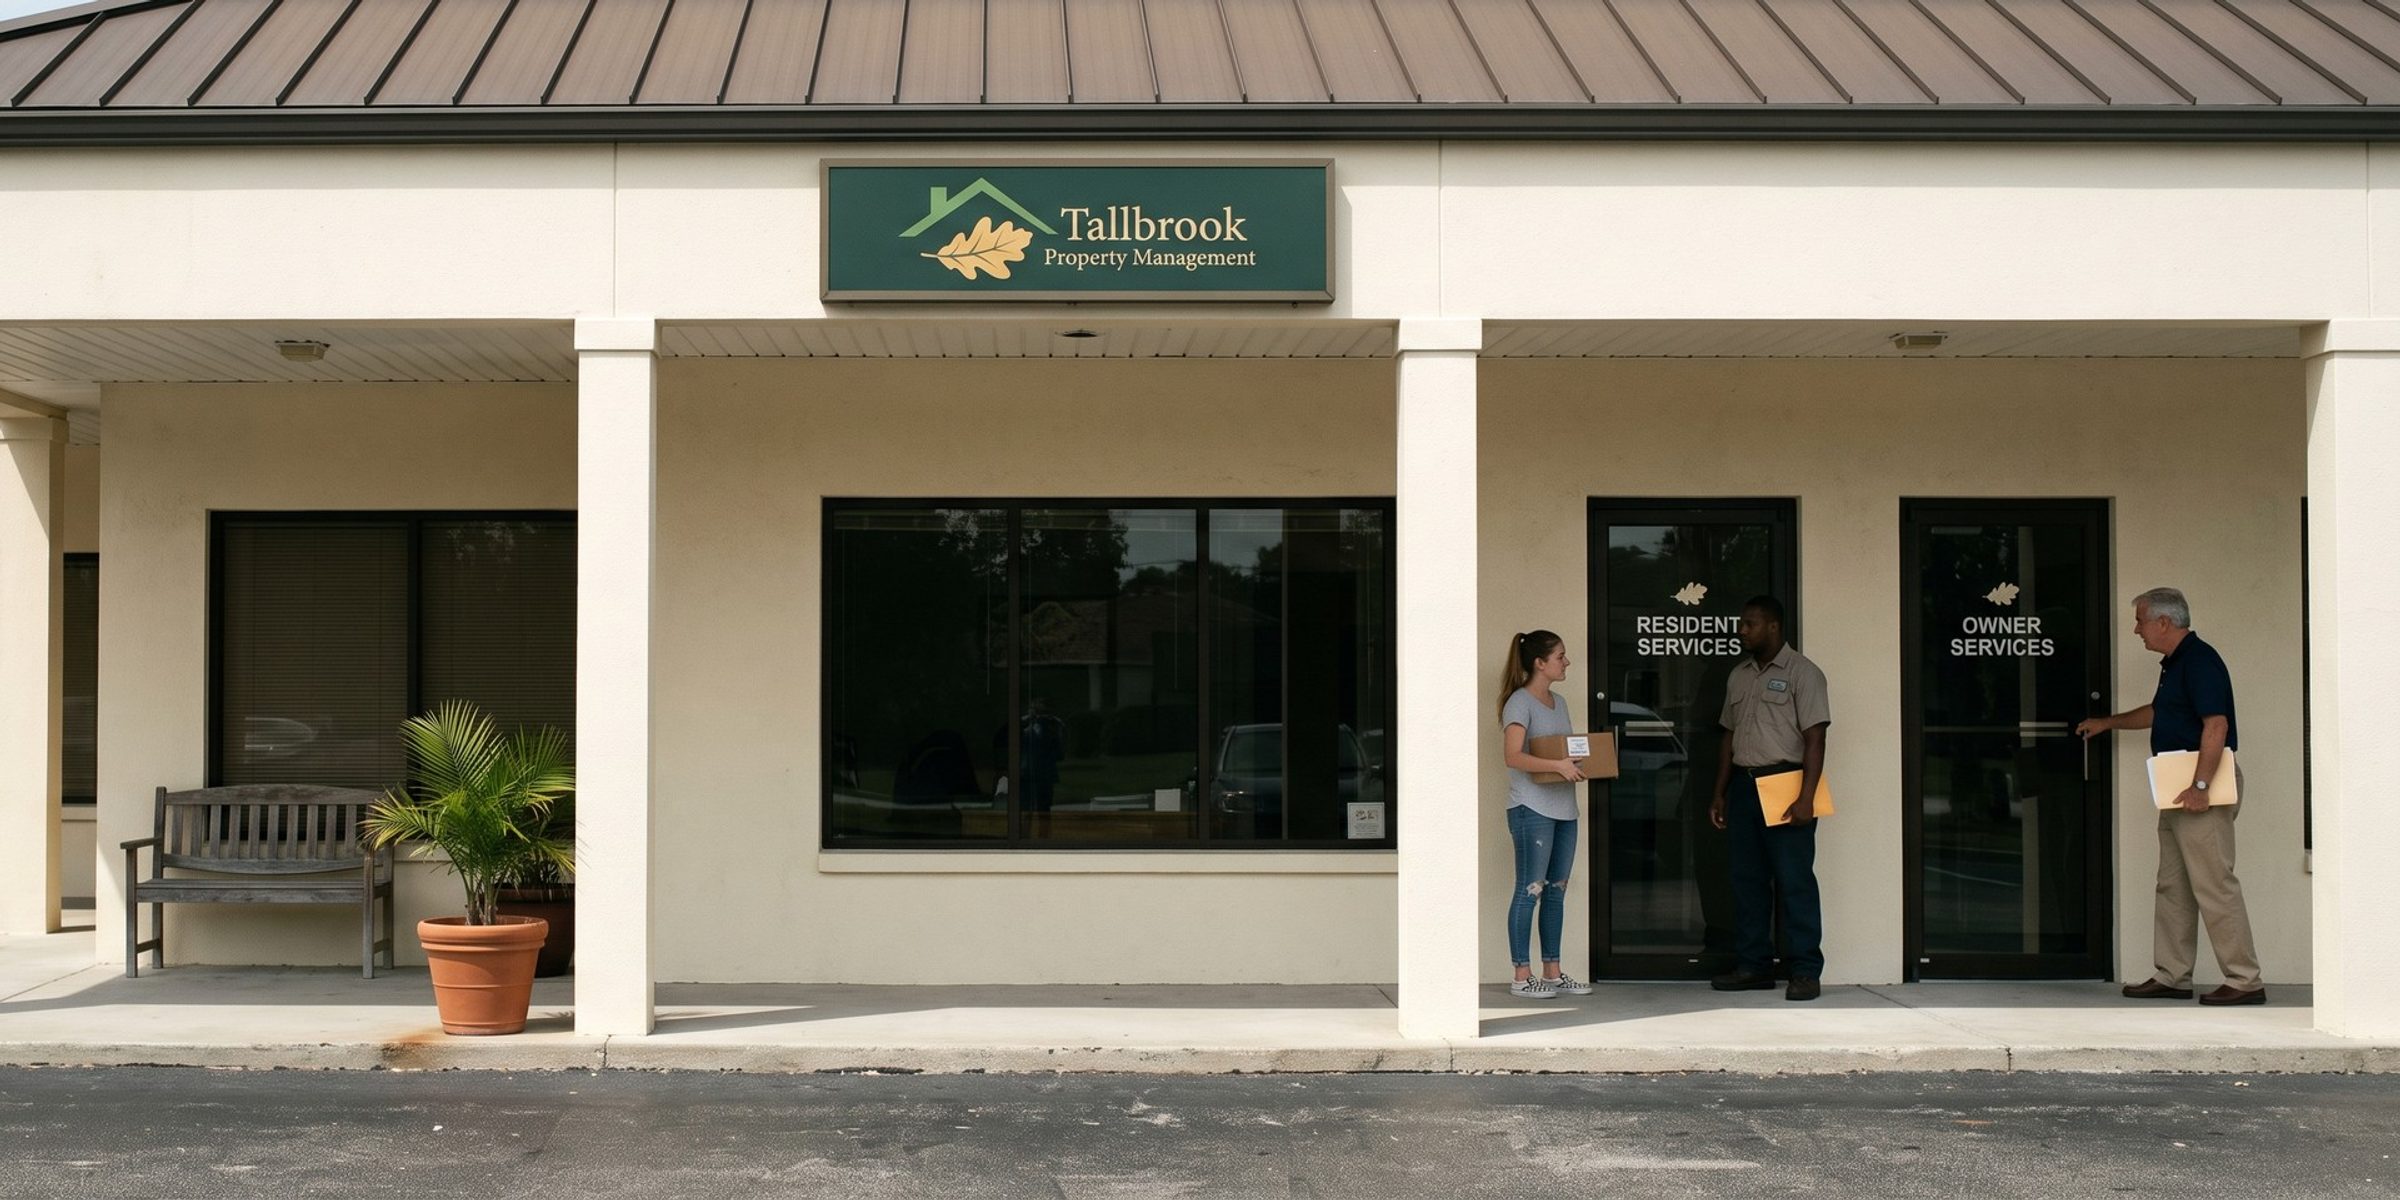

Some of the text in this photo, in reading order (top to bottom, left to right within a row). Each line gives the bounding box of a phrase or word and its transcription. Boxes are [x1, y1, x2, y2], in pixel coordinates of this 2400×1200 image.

[1060, 205, 1248, 242] Tallbrook
[1044, 248, 1256, 272] Property Management
[1637, 616, 1741, 634] RESIDENT
[1962, 616, 2042, 634] OWNER
[1637, 638, 1742, 656] SERVICES
[1950, 638, 2055, 656] SERVICES
